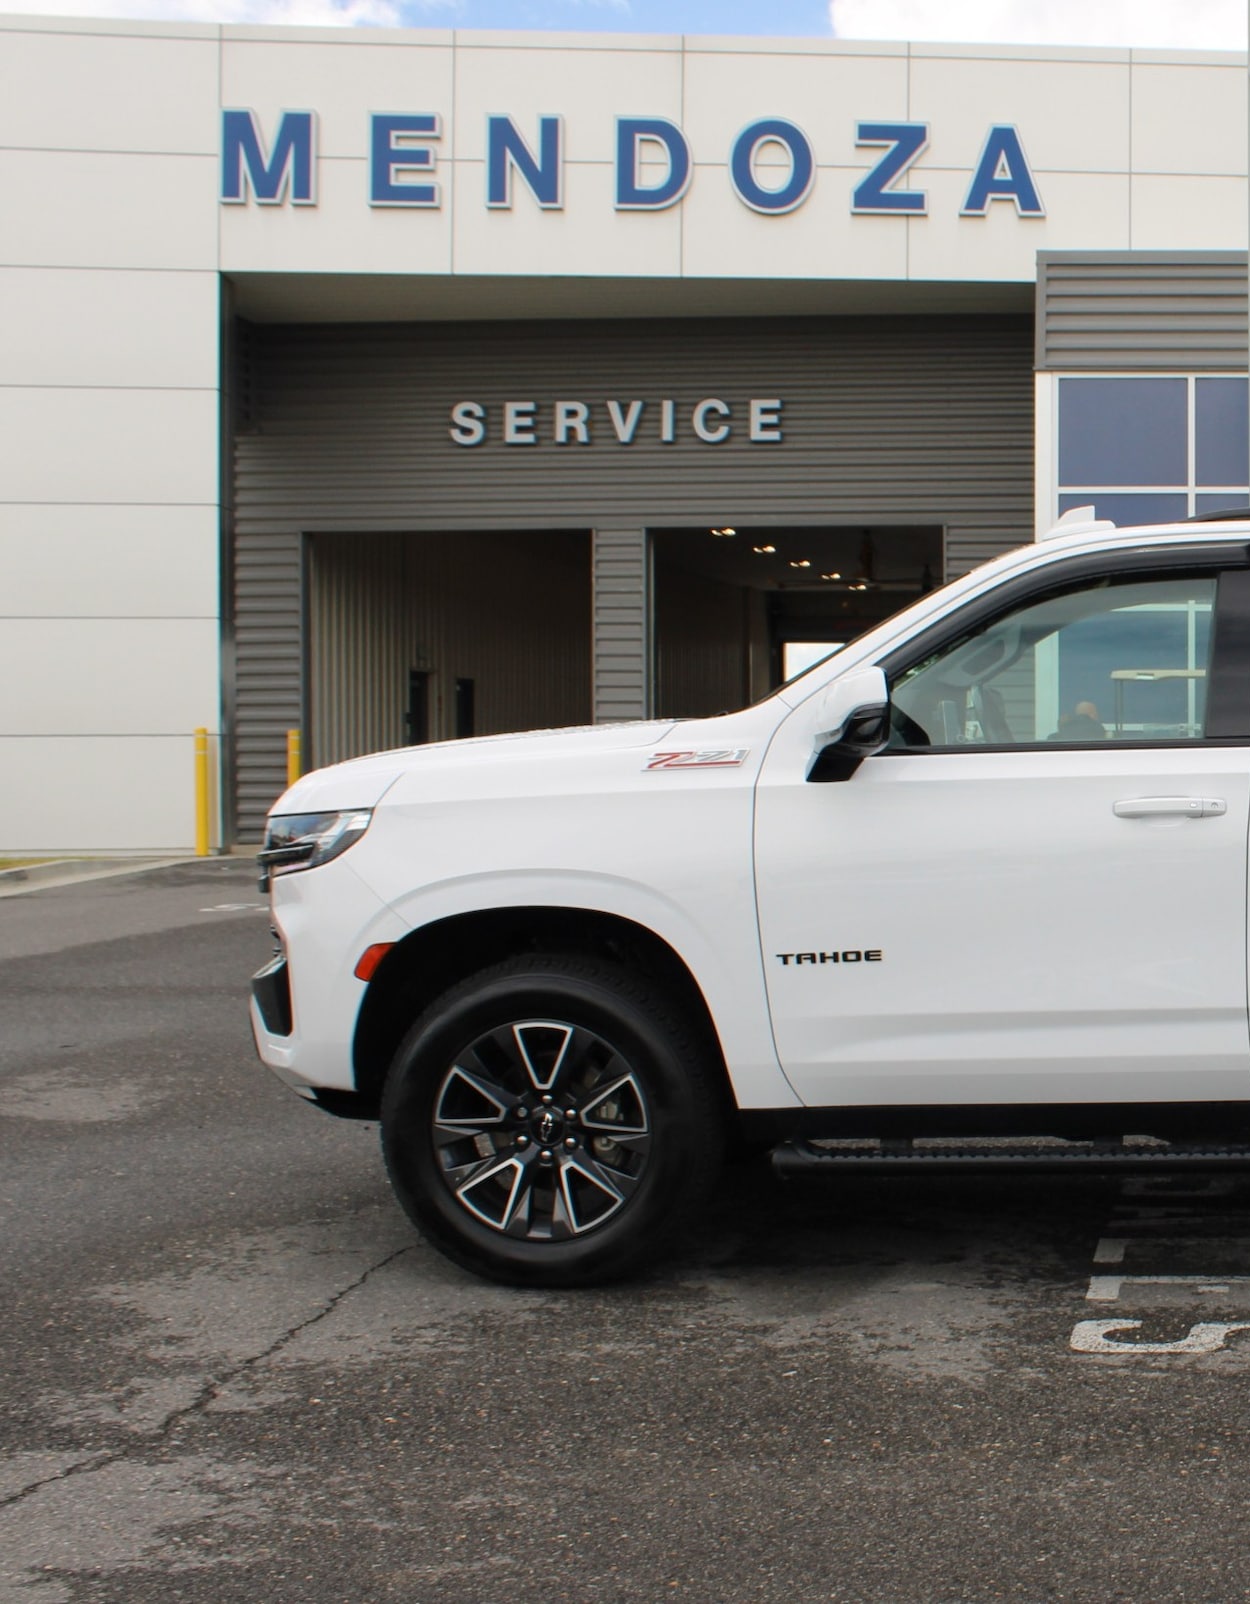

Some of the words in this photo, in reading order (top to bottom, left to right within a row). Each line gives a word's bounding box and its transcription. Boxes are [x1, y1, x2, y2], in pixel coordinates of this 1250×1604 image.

[219, 107, 1046, 218] MENDOZA
[449, 397, 785, 446] SERVICE
[646, 748, 751, 769] Z71
[775, 949, 883, 966] TAHOE
